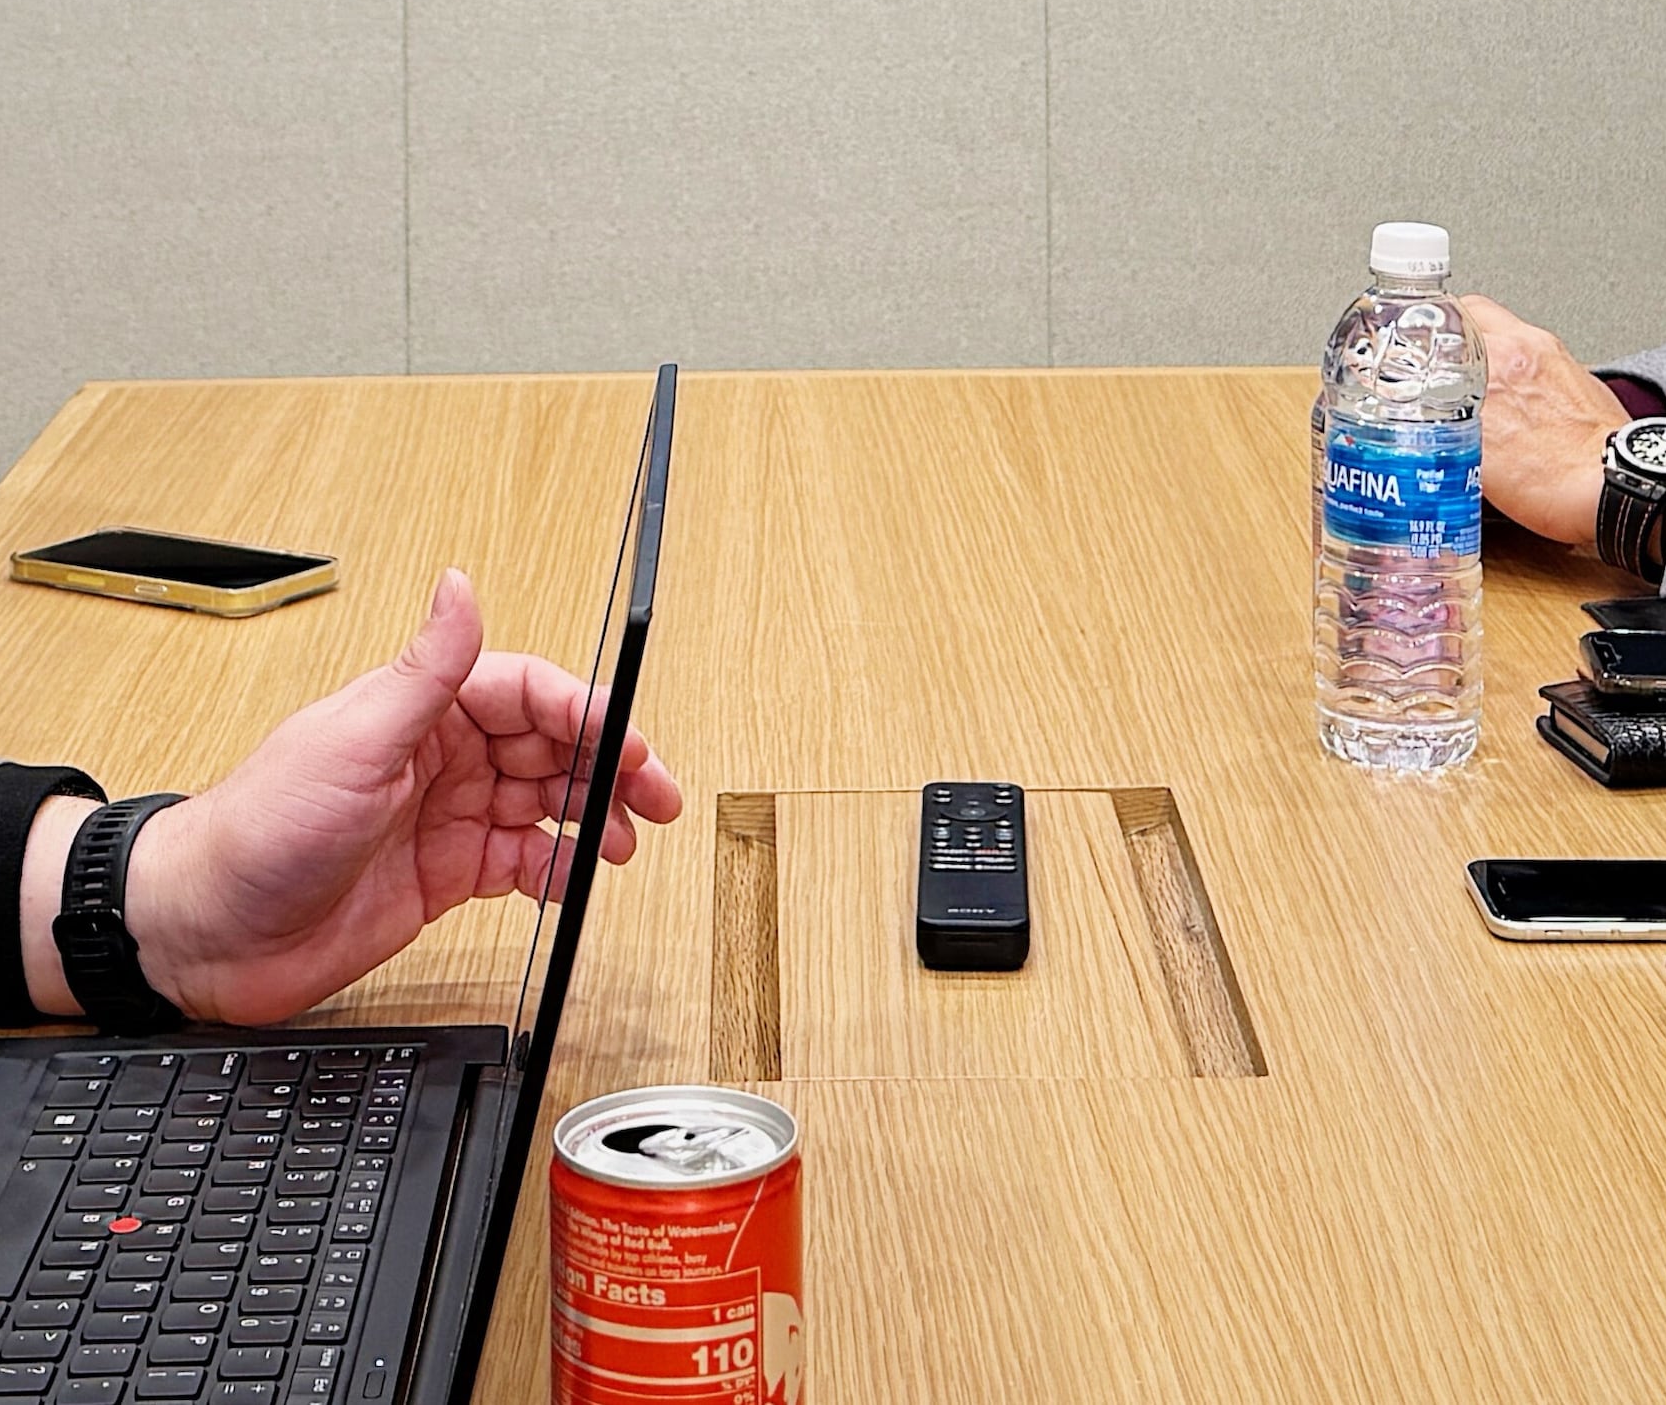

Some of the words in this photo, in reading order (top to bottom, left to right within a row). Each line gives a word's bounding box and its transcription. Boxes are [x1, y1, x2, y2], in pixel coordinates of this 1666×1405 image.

[594, 1273, 666, 1306] Facts
[712, 1308, 720, 1323] 1
[726, 1302, 755, 1320] can
[691, 1338, 754, 1376] 110
